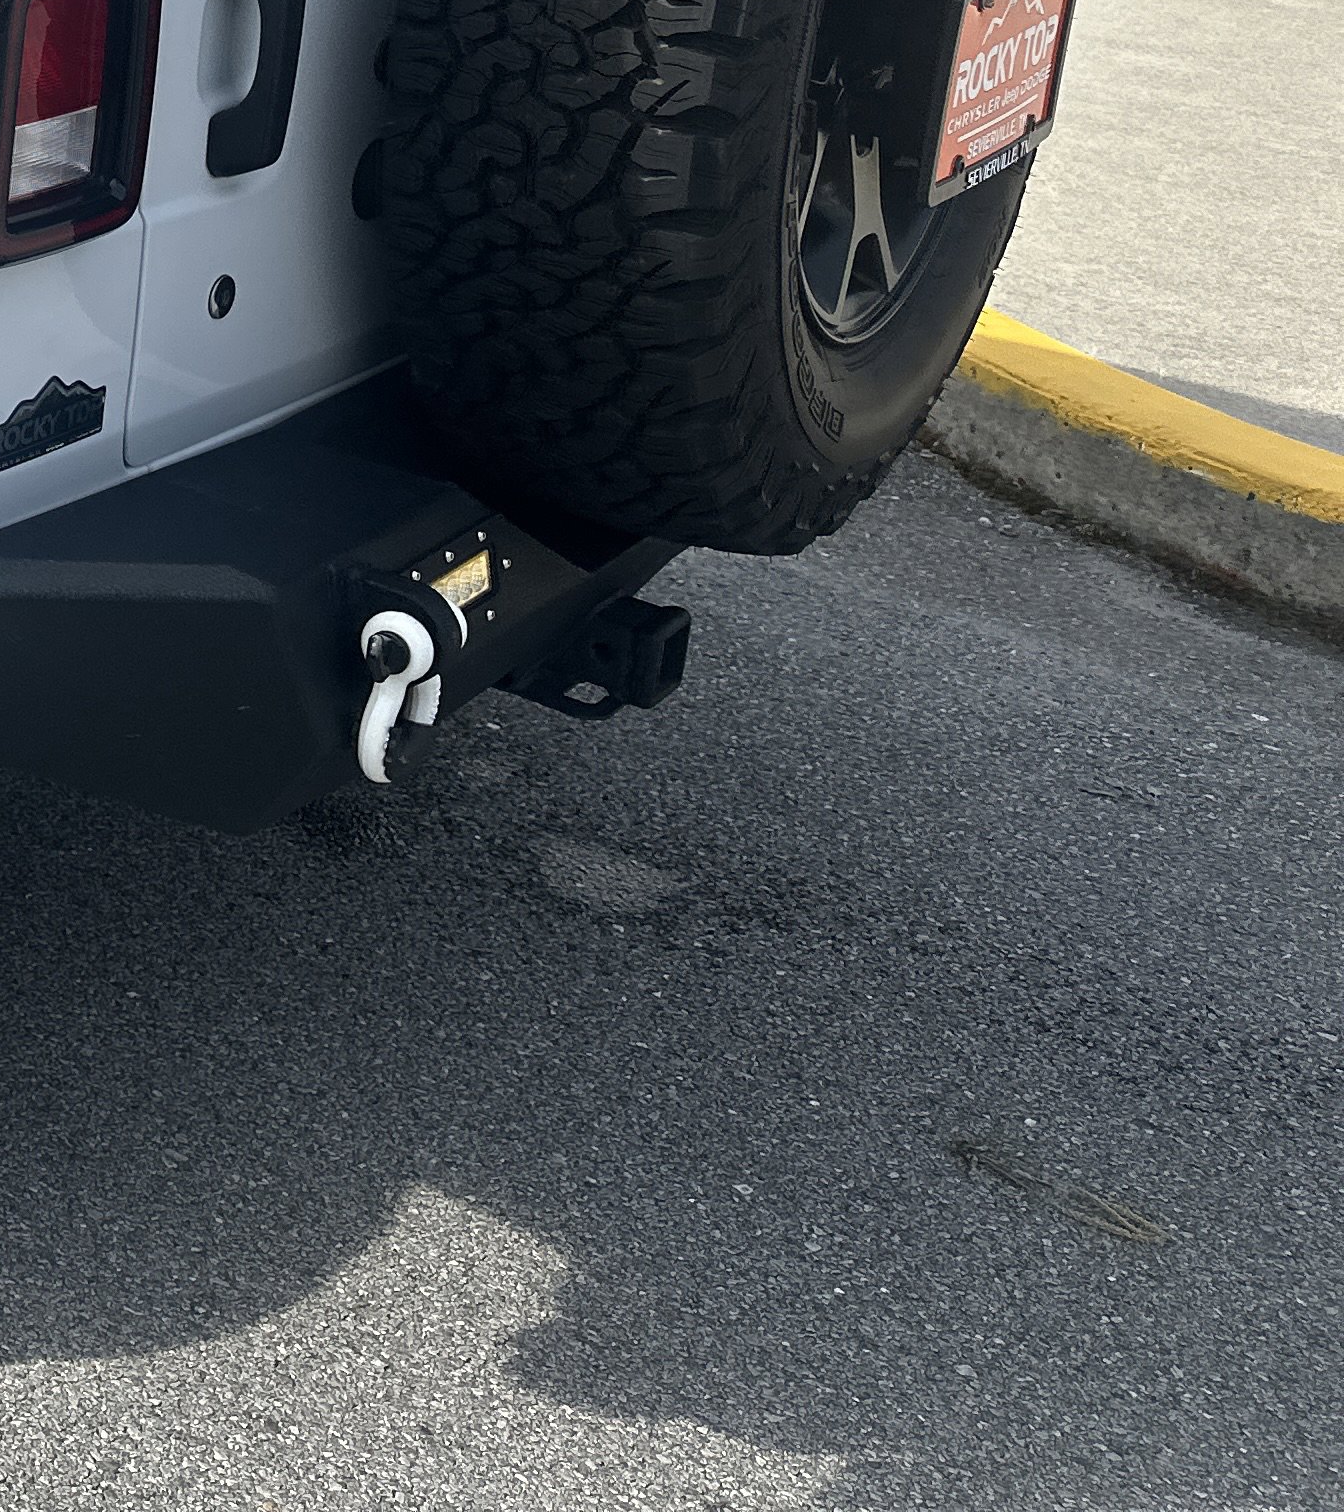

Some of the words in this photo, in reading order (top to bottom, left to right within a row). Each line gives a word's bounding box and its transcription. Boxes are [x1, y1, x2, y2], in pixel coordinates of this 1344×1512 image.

[946, 95, 1000, 135] CHRYSLER
[1000, 88, 1019, 108] Jeep
[1019, 63, 1052, 96] DODGE
[952, 36, 1020, 109] ROCKY
[1021, 14, 1059, 71] TOP
